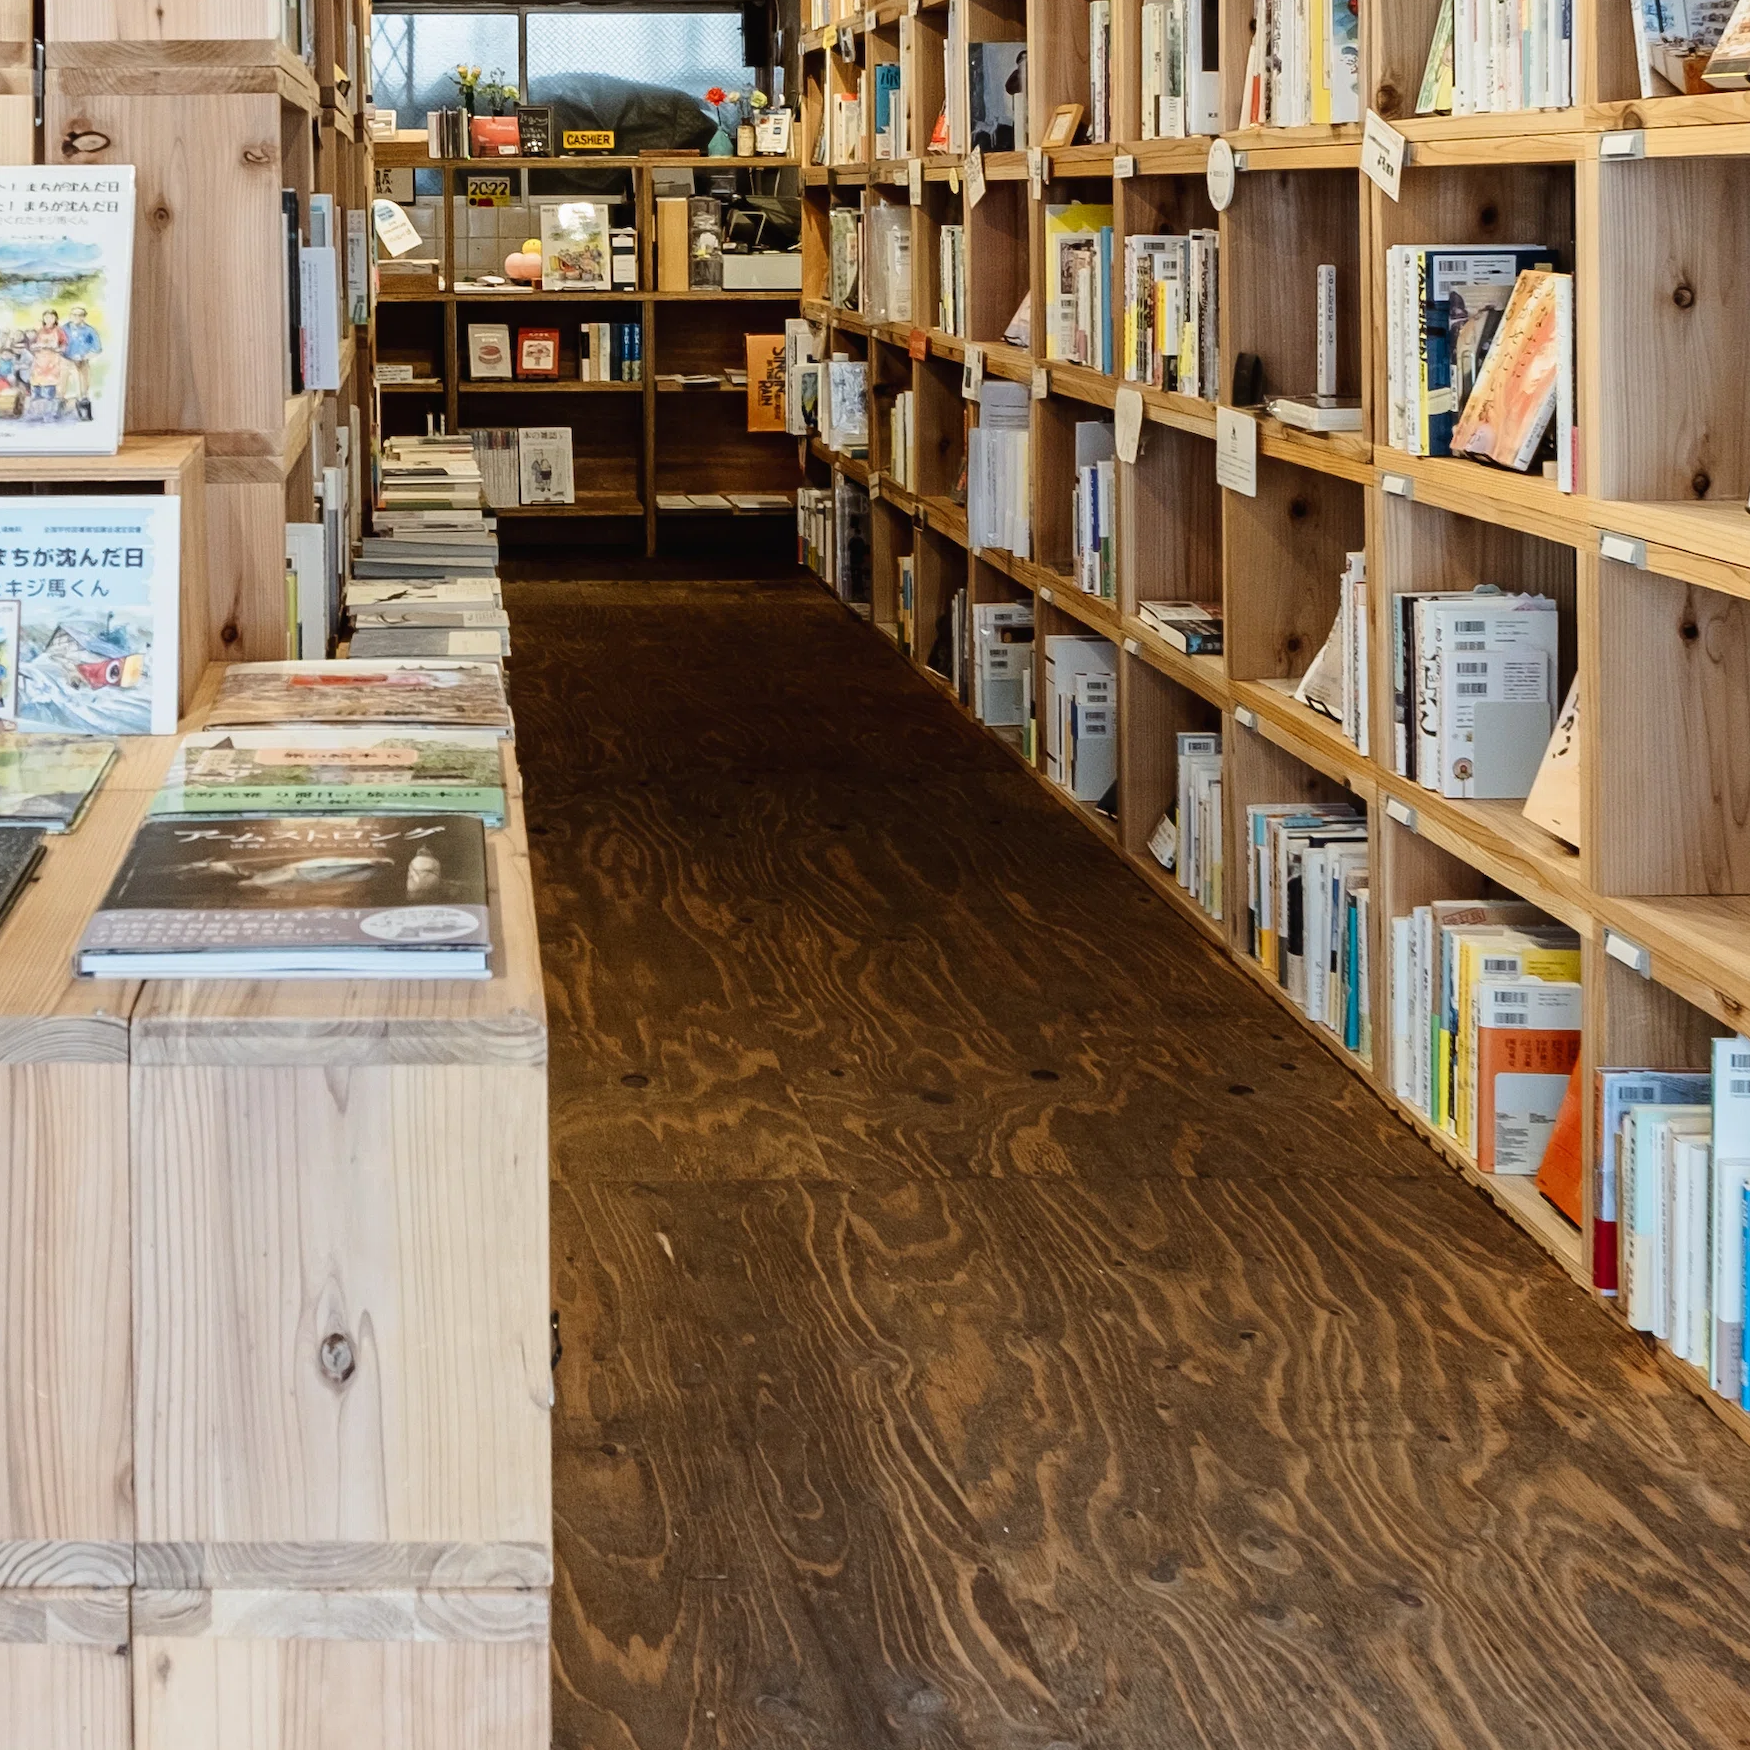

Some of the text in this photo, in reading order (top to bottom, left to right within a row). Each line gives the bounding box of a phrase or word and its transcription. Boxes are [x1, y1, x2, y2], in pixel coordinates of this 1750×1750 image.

[566, 133, 611, 147] CASHIER
[469, 181, 509, 197] 2022
[173, 825, 446, 843] アームストロング
